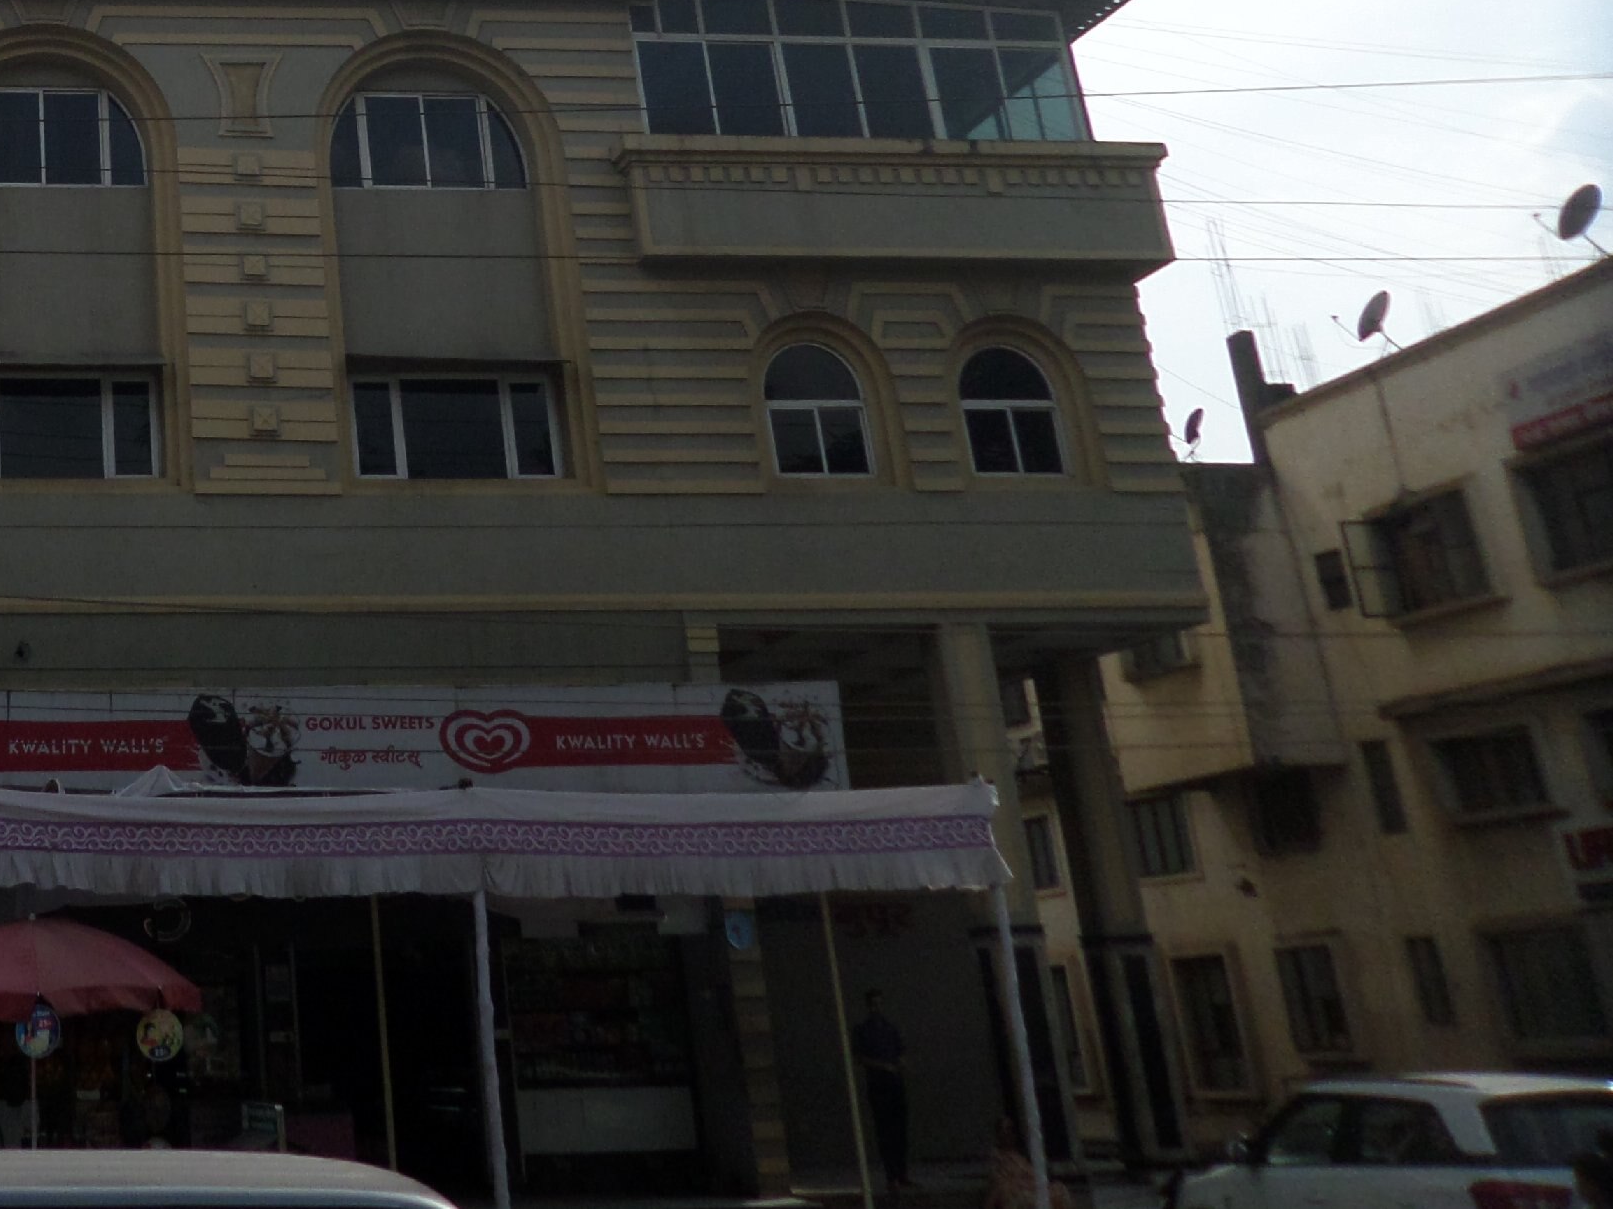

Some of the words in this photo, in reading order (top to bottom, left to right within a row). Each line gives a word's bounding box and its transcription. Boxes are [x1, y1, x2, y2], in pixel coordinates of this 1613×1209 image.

[305, 716, 366, 731] GOKUL
[371, 715, 435, 730] SWEETS
[8, 738, 92, 755] KWALITY
[99, 737, 165, 754] WALL'S
[556, 734, 637, 750] KWALITY
[643, 733, 706, 749] WALL'S
